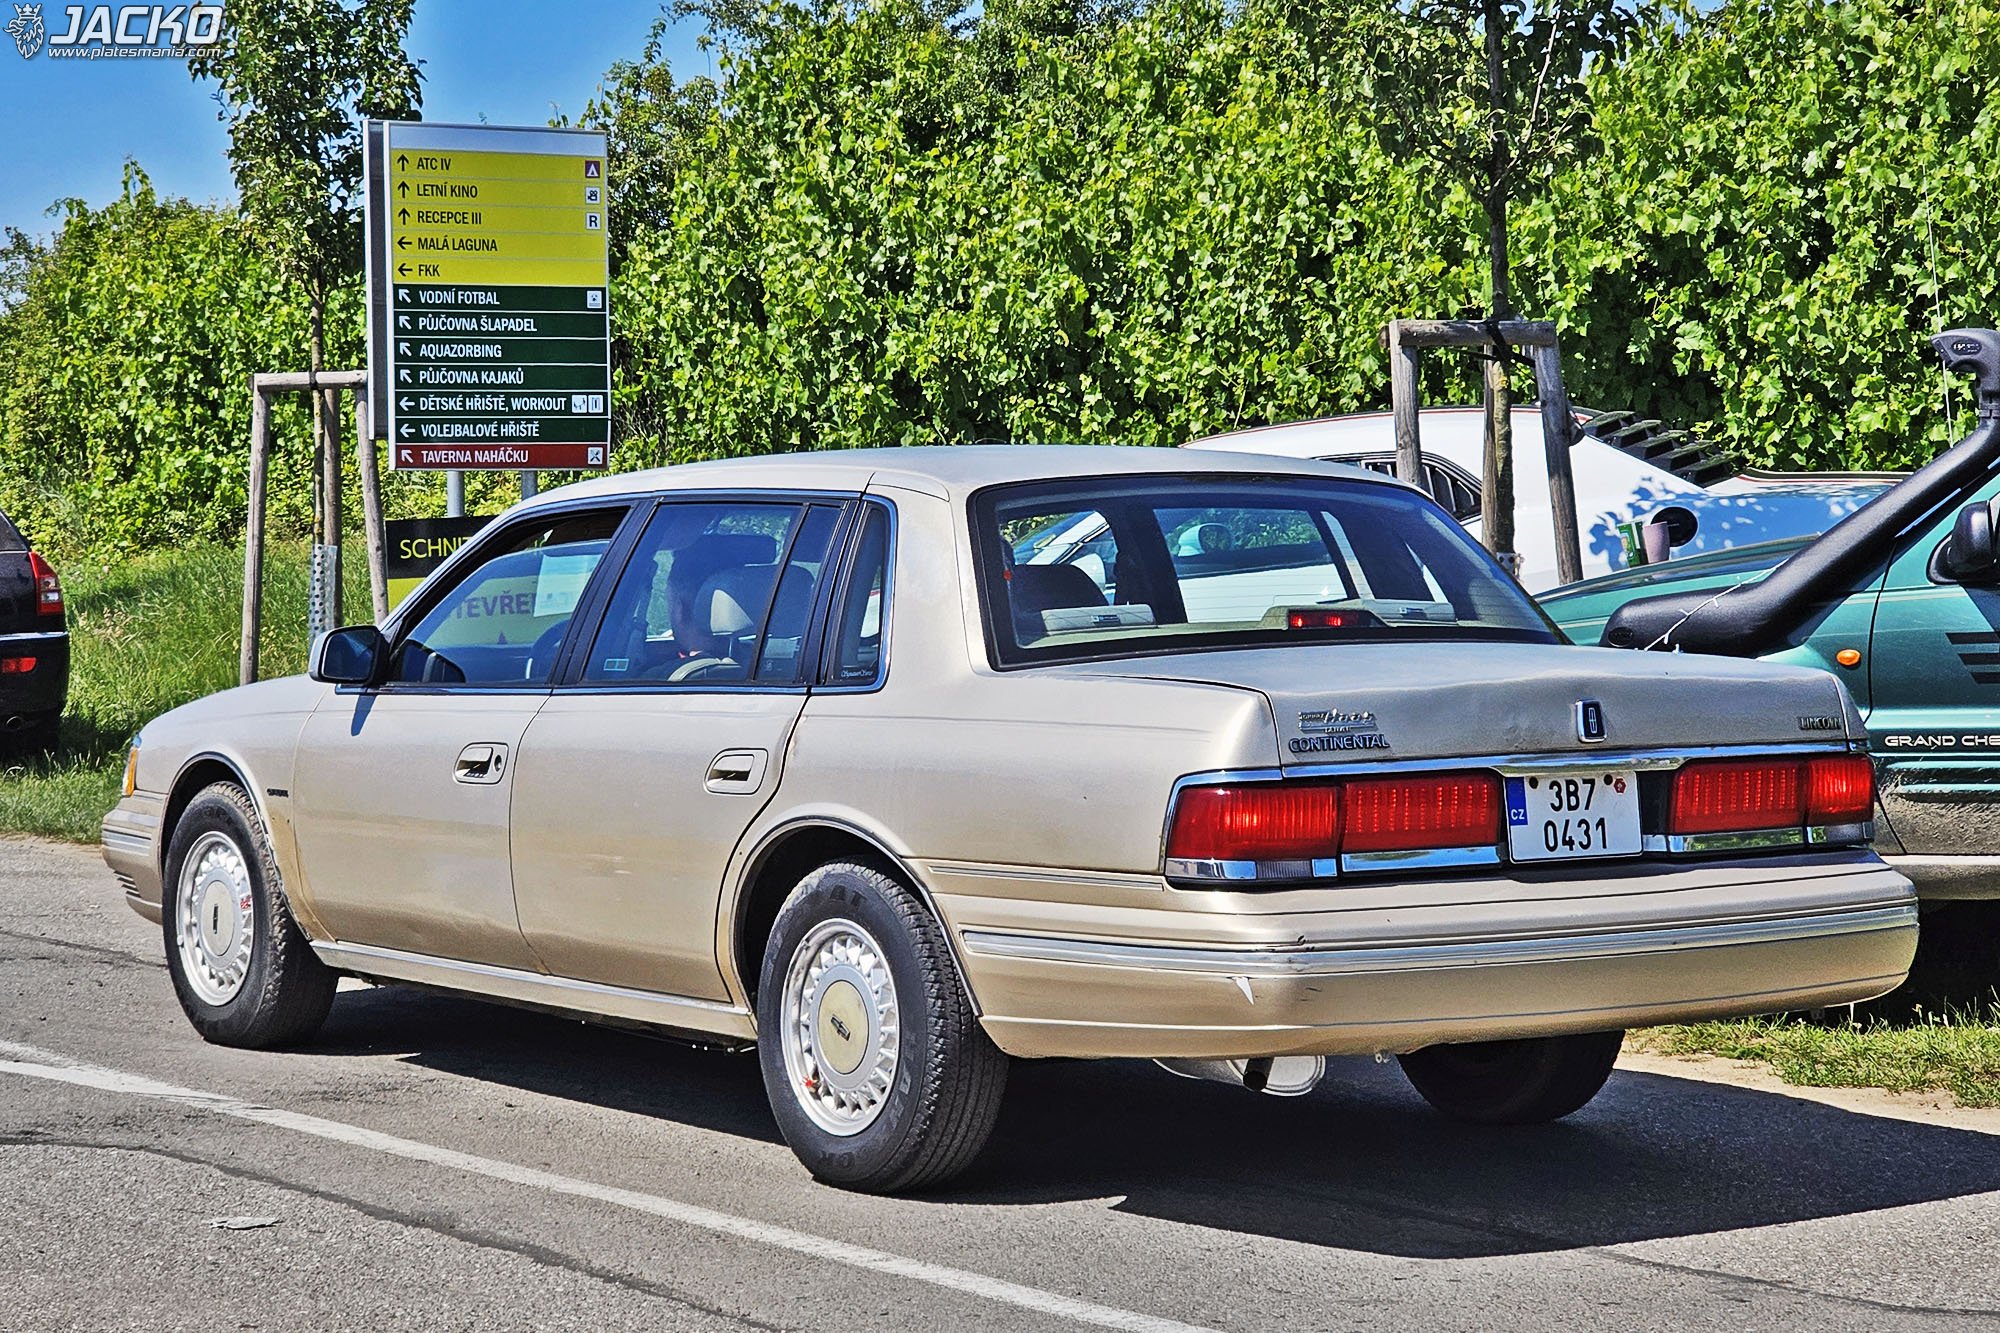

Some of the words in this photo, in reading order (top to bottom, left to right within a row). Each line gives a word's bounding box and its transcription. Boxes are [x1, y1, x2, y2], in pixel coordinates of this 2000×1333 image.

[416, 157, 438, 170] ATC
[440, 157, 452, 171] IV
[416, 181, 448, 198] LETNÍ
[450, 184, 478, 199] KINO
[417, 210, 470, 225] RECEPCE
[471, 211, 482, 225] III
[588, 215, 598, 228] R
[417, 235, 450, 251] MALÁ
[452, 238, 498, 252] LAGUNA
[418, 264, 441, 277] FKK
[419, 288, 455, 304] VODNÍ
[457, 291, 500, 305] FOTBAL
[418, 313, 478, 331] PŮJČOVNA
[480, 314, 537, 332] ŠLAPADEL
[419, 343, 502, 359] AQUAZORBING
[419, 367, 479, 384] PŮJČOVNA
[481, 367, 524, 385] KAJAKŮ
[419, 394, 464, 411] DĚTSKÉ
[465, 394, 509, 413] HŘIŠTĚ,
[511, 397, 567, 411] WORKOUT
[420, 420, 498, 438] VOLEJBALOVÉ
[500, 420, 540, 438] HŘIŠTĚ
[421, 449, 472, 464] TAVERNA
[473, 447, 529, 464] NAHÁČKU
[1288, 734, 1391, 754] CONTINENTAL
[1884, 735, 1956, 747] GRAND
[1548, 778, 1596, 812] 3B7
[1510, 808, 1525, 820] CZ
[1543, 817, 1607, 853] 0431
